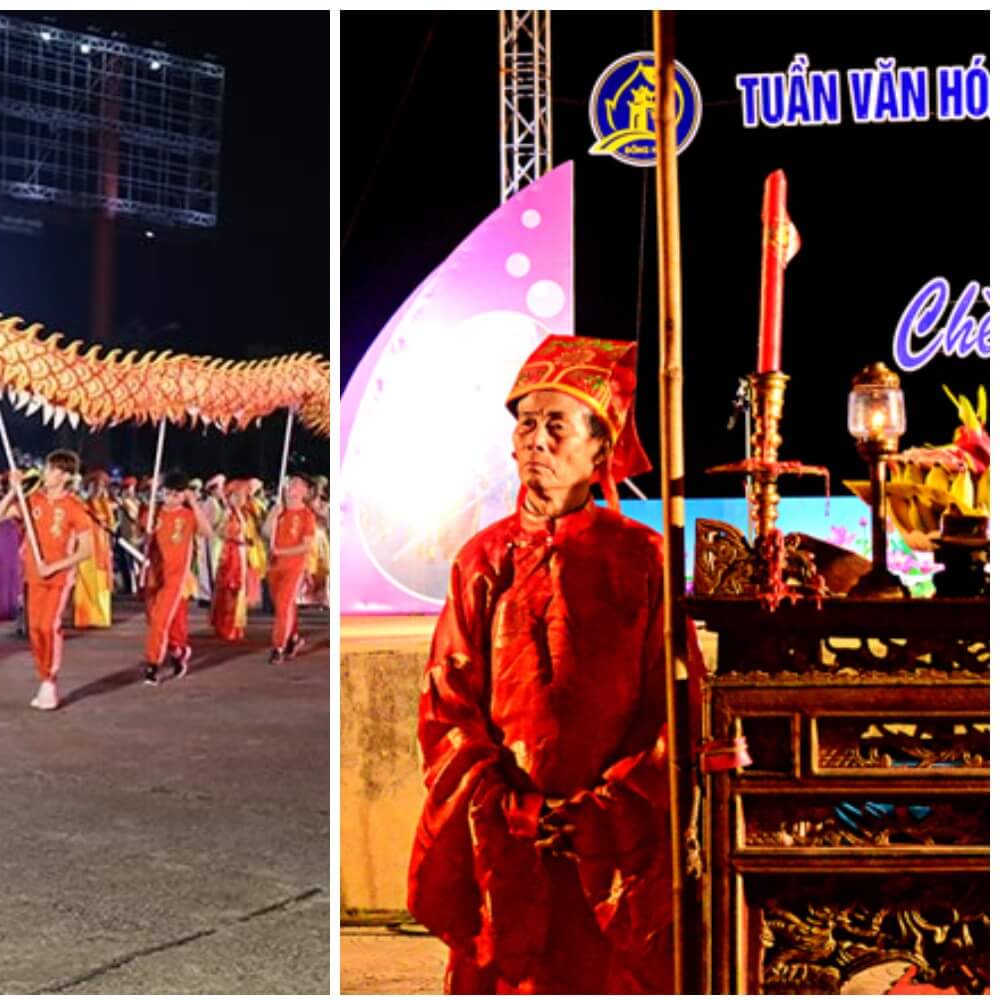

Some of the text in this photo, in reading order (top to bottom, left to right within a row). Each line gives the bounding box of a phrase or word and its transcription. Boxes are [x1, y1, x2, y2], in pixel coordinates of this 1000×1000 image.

[736, 53, 990, 128] TUẦN VĂN HÓ
